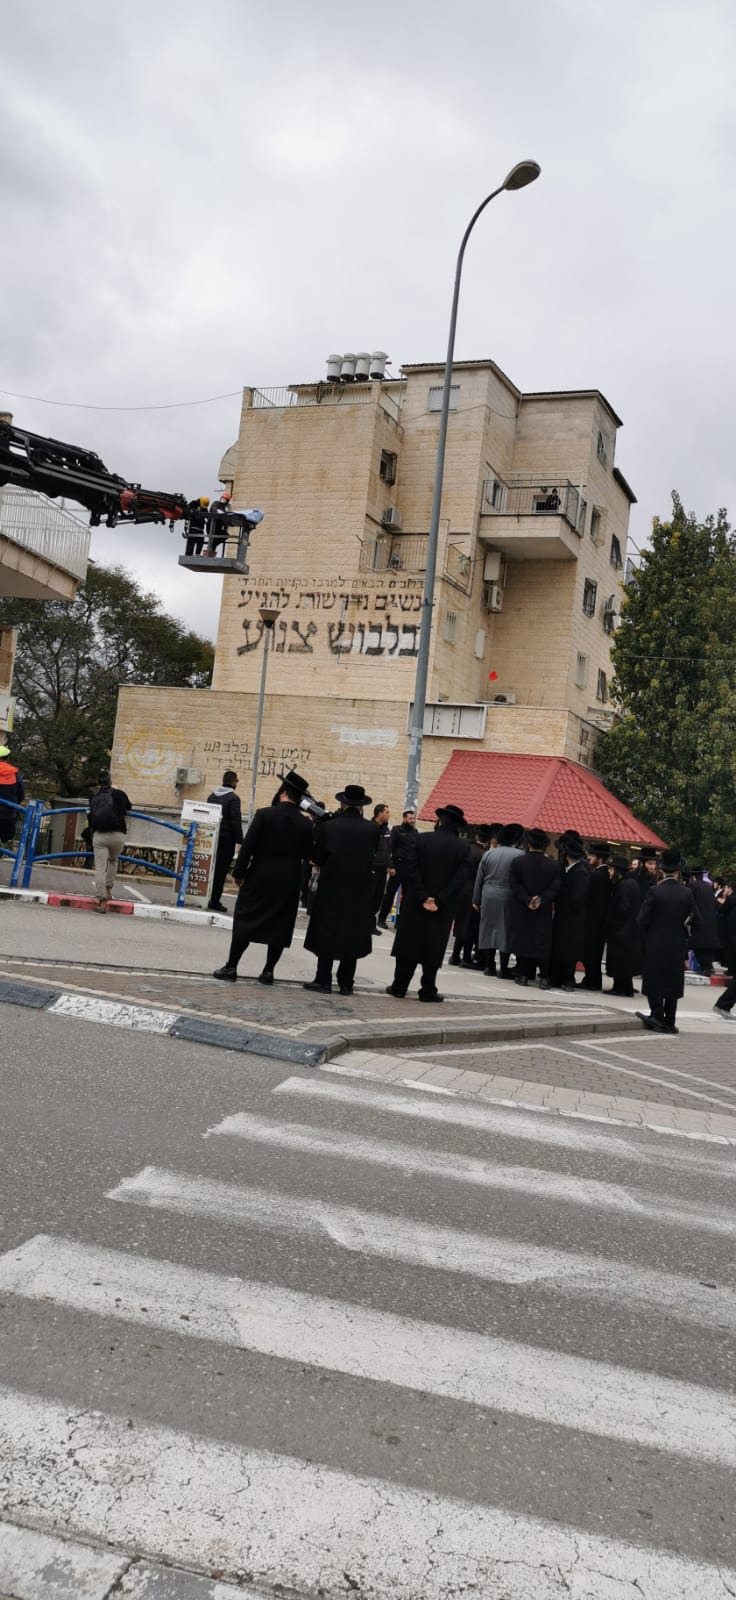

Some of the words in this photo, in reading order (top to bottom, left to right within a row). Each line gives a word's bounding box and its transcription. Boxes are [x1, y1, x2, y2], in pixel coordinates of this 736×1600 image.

[237, 587, 291, 608] להגיע
[375, 593, 422, 612] נשים
[237, 618, 318, 656] צנוע
[328, 615, 419, 657] בלבוש
